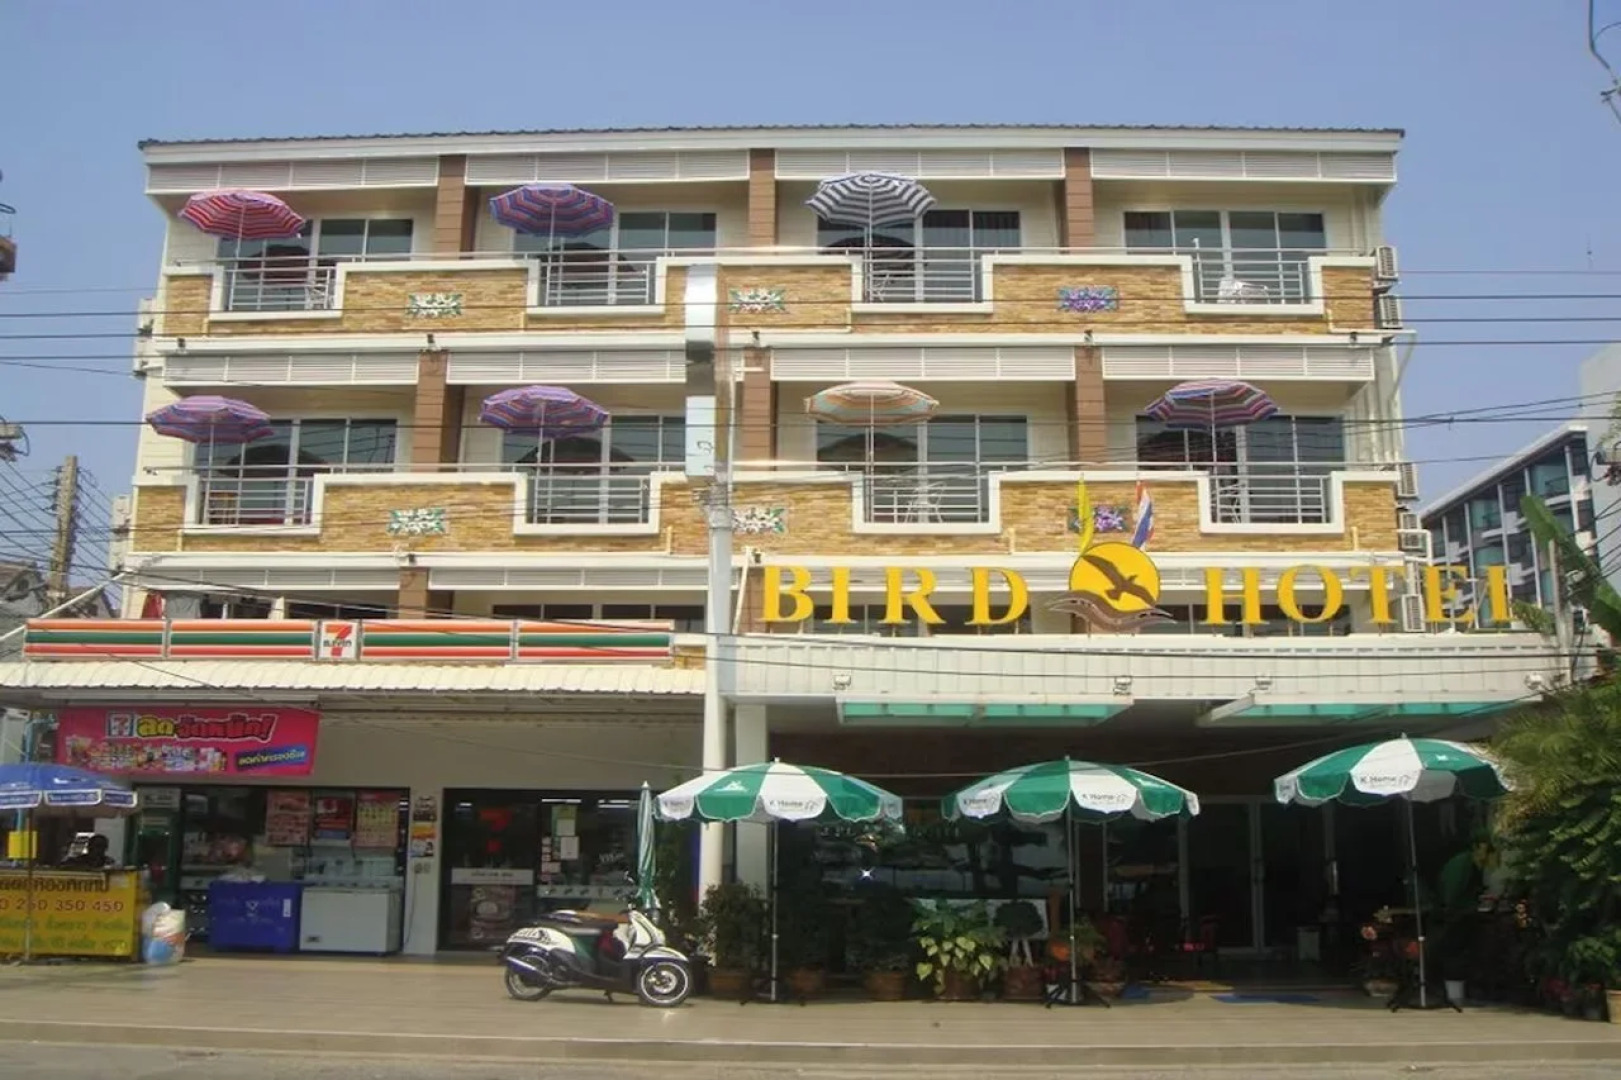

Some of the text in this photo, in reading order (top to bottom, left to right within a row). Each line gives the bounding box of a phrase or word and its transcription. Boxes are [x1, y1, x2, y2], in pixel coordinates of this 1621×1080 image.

[759, 566, 1029, 625] BIRD
[55, 900, 86, 911] 350
[92, 900, 124, 912] 450
